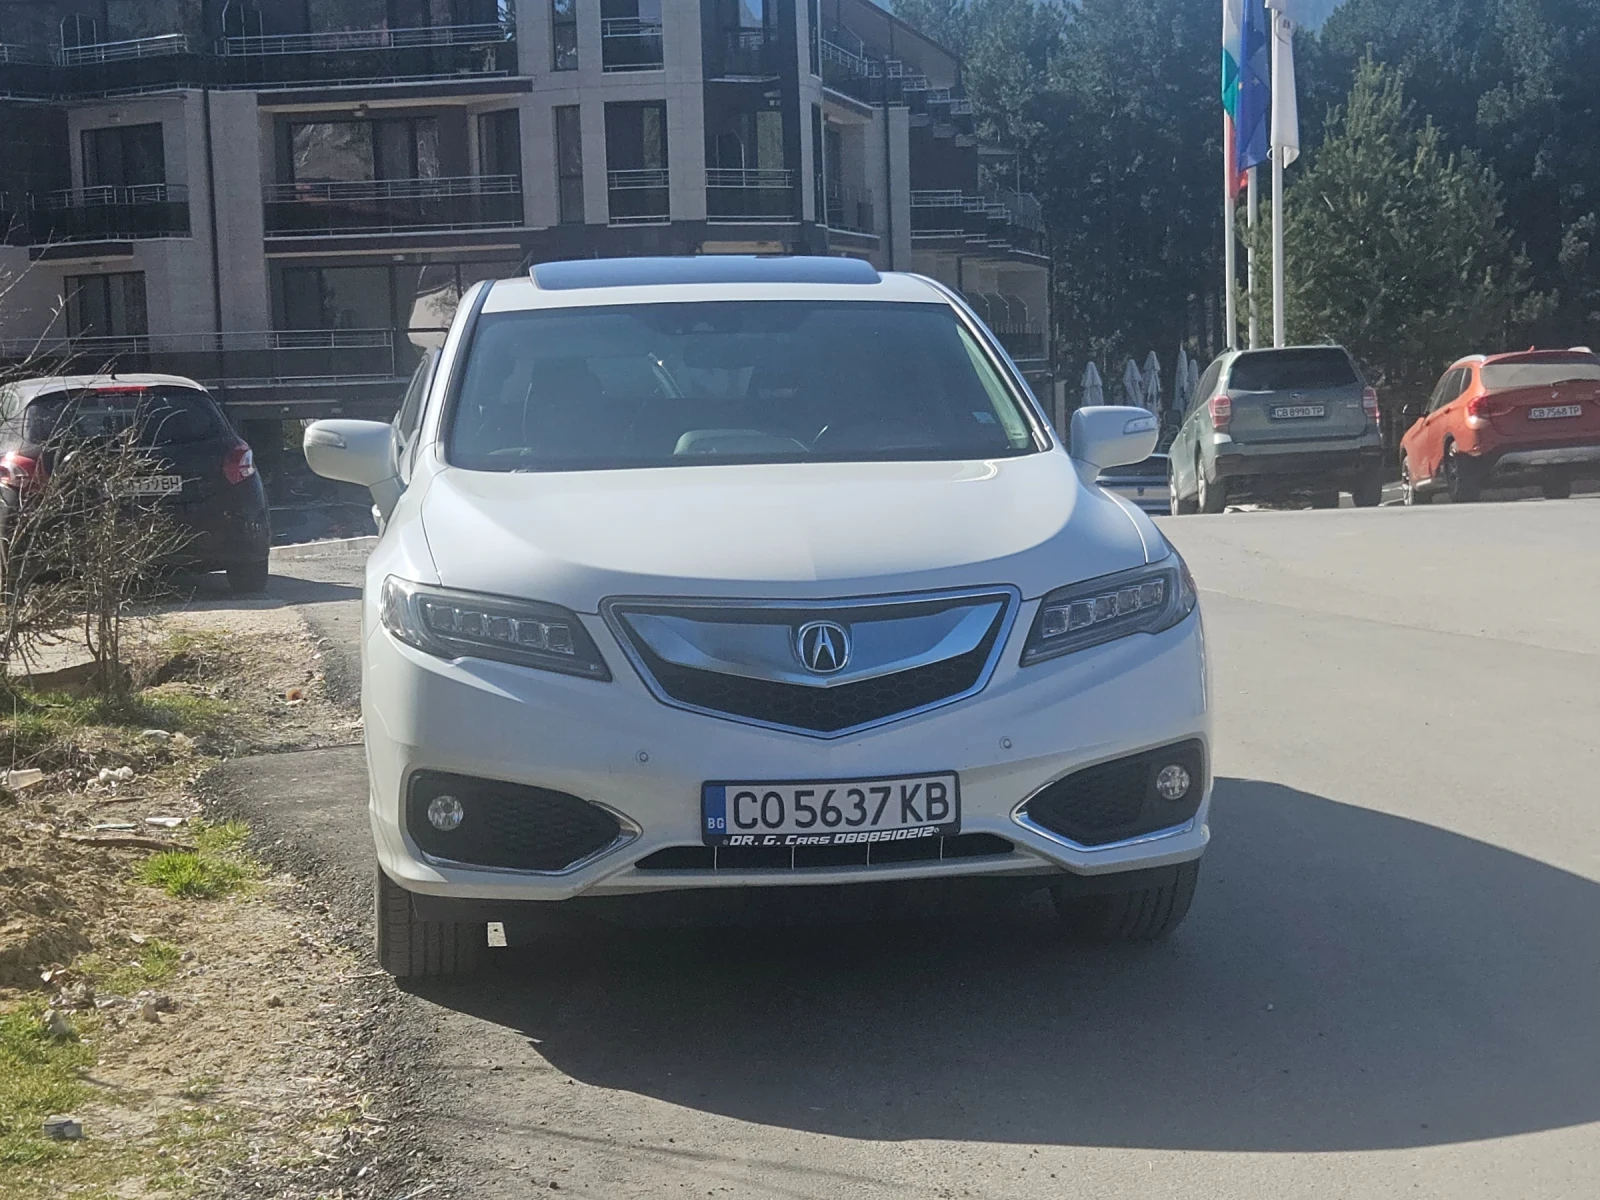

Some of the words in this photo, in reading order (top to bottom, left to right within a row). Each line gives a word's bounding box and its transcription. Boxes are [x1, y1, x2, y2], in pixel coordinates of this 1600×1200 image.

[1276, 408, 1288, 417] CB
[1289, 407, 1311, 417] 8990
[1311, 407, 1323, 415] TP
[1533, 409, 1545, 418] CB
[1568, 406, 1579, 415] TP
[733, 791, 785, 829] CO
[794, 785, 891, 828] 5637
[900, 781, 949, 824] KB
[707, 817, 725, 829] BG
[729, 835, 759, 846] DR.
[762, 835, 781, 846] G.
[833, 826, 935, 844] 0888510212
